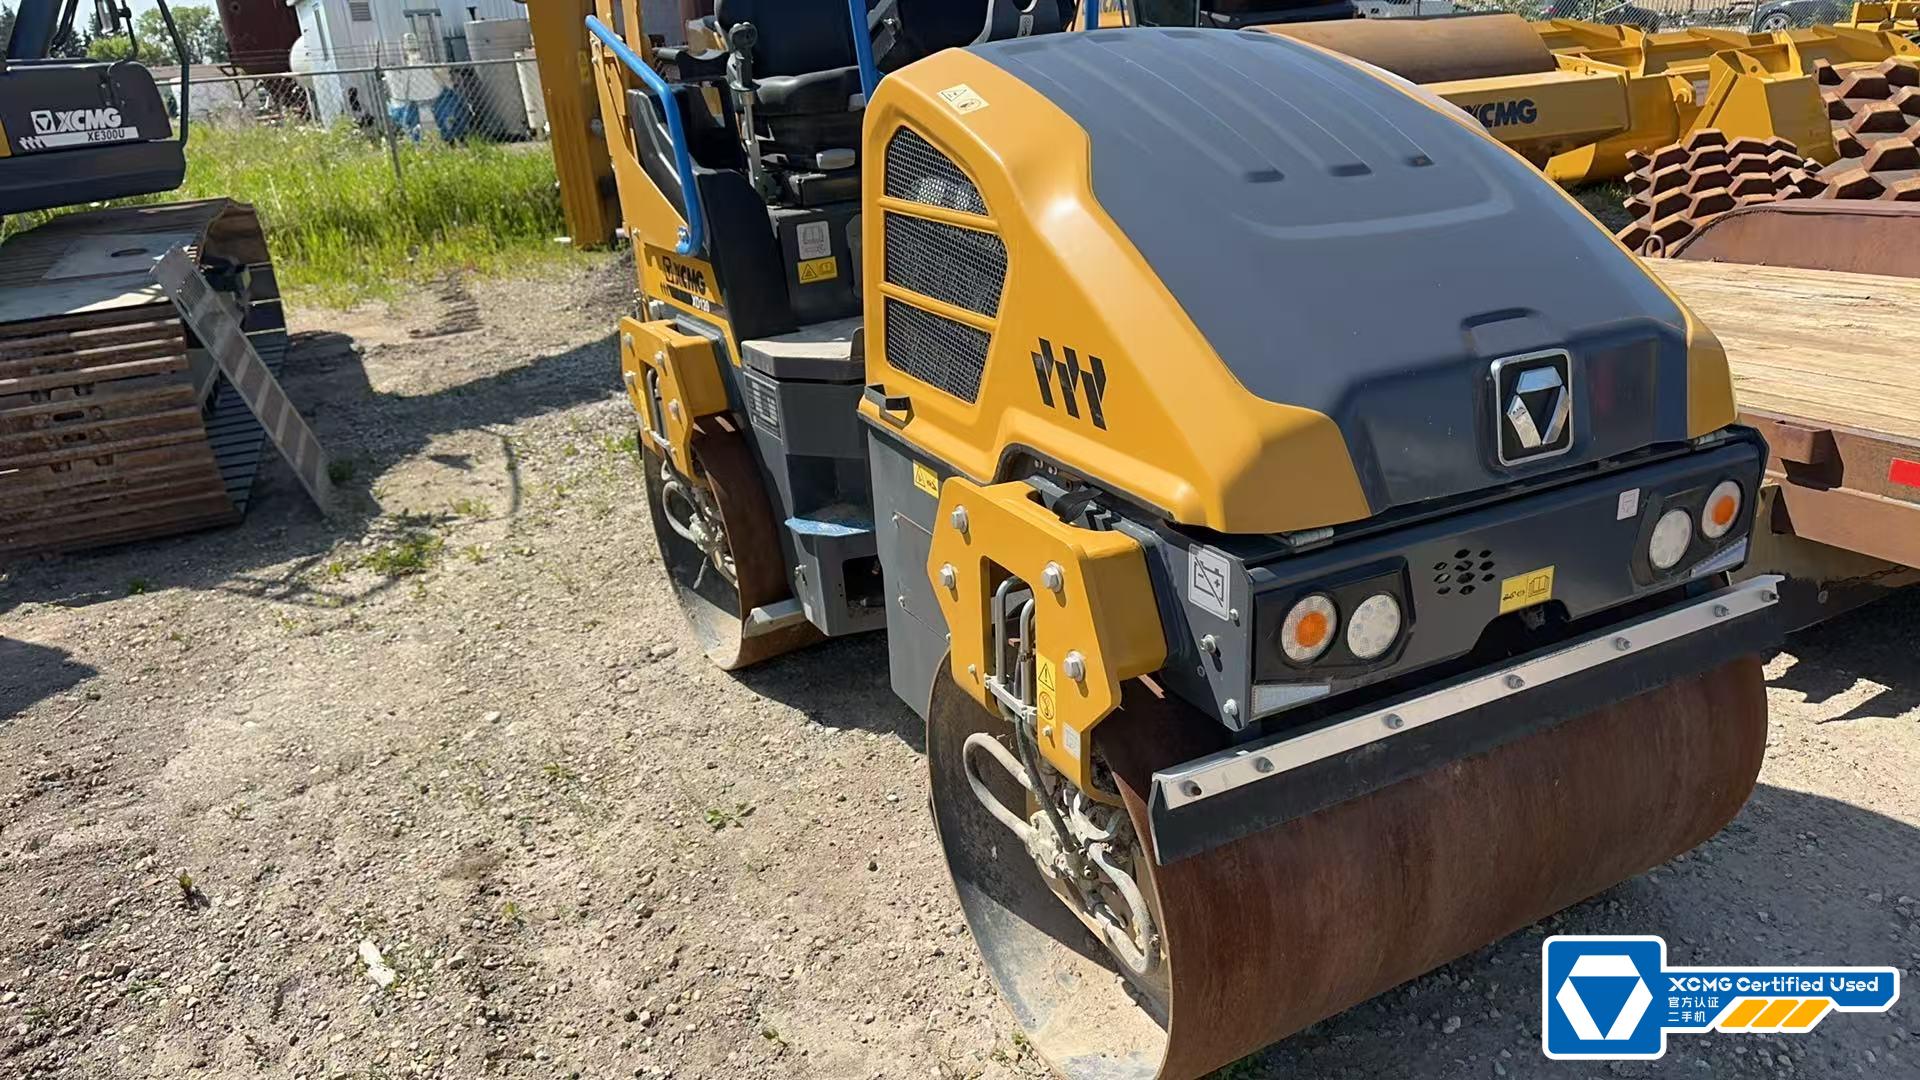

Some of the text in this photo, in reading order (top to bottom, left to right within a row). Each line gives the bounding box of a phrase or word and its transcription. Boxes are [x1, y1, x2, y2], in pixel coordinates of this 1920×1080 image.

[55, 107, 122, 133] XCMG
[87, 129, 125, 142] XE300U
[673, 262, 706, 296] XCMG
